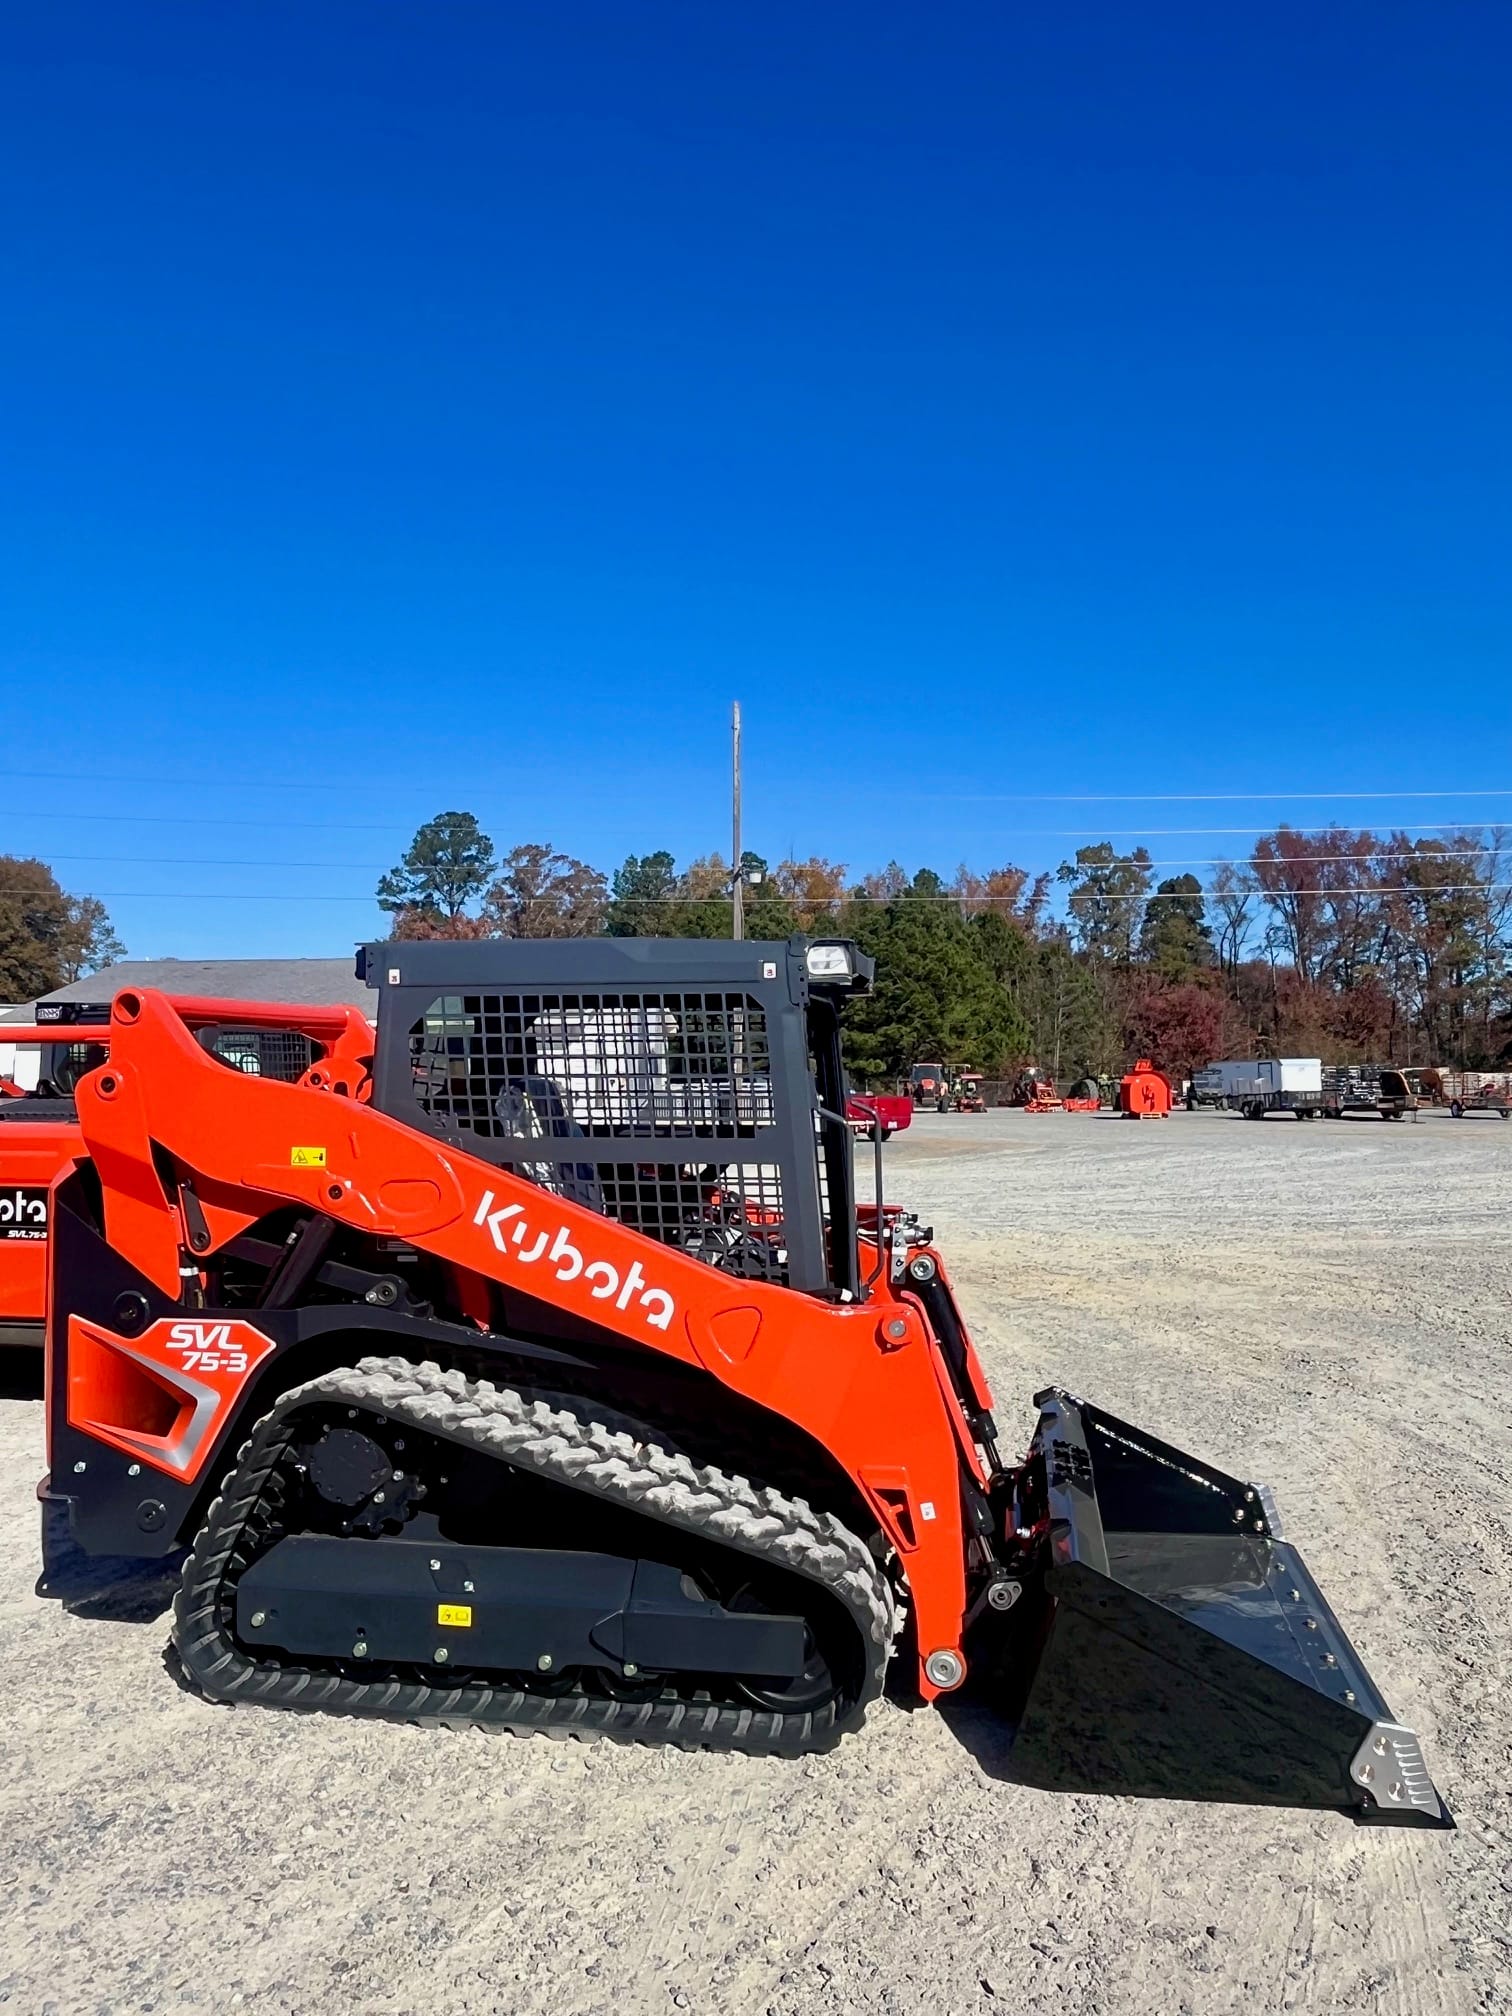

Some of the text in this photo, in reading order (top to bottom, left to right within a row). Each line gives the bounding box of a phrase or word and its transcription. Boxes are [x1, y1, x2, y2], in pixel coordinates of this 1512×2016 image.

[473, 1189, 675, 1331] Kubota
[165, 1324, 243, 1350] SVL
[181, 1351, 248, 1372] 75-3
